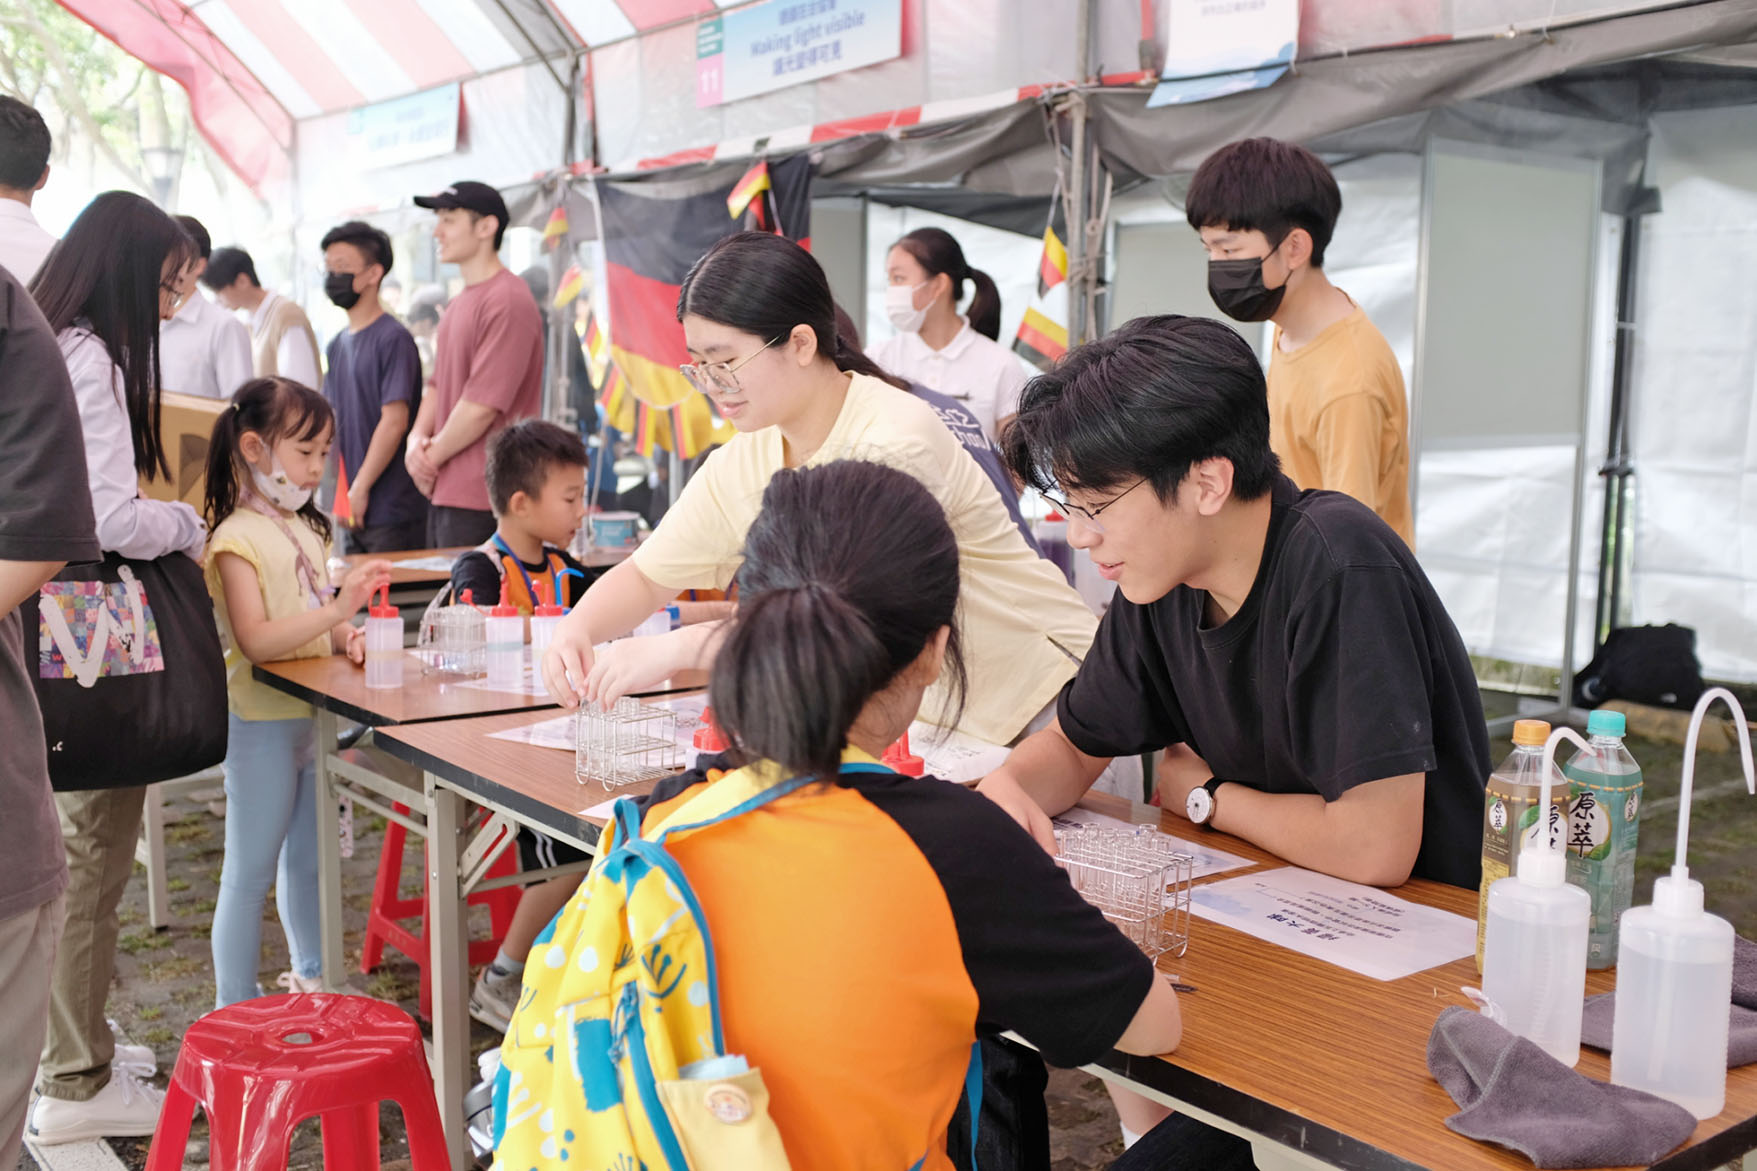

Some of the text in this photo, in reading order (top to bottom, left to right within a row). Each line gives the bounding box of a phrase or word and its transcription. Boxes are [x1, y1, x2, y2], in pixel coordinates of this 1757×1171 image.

[750, 33, 792, 57] Making
[794, 24, 822, 48] light
[825, 11, 866, 35] visible
[773, 39, 842, 77] 讓光變得可見
[701, 68, 719, 94] 11
[1568, 791, 1595, 858] 原萃
